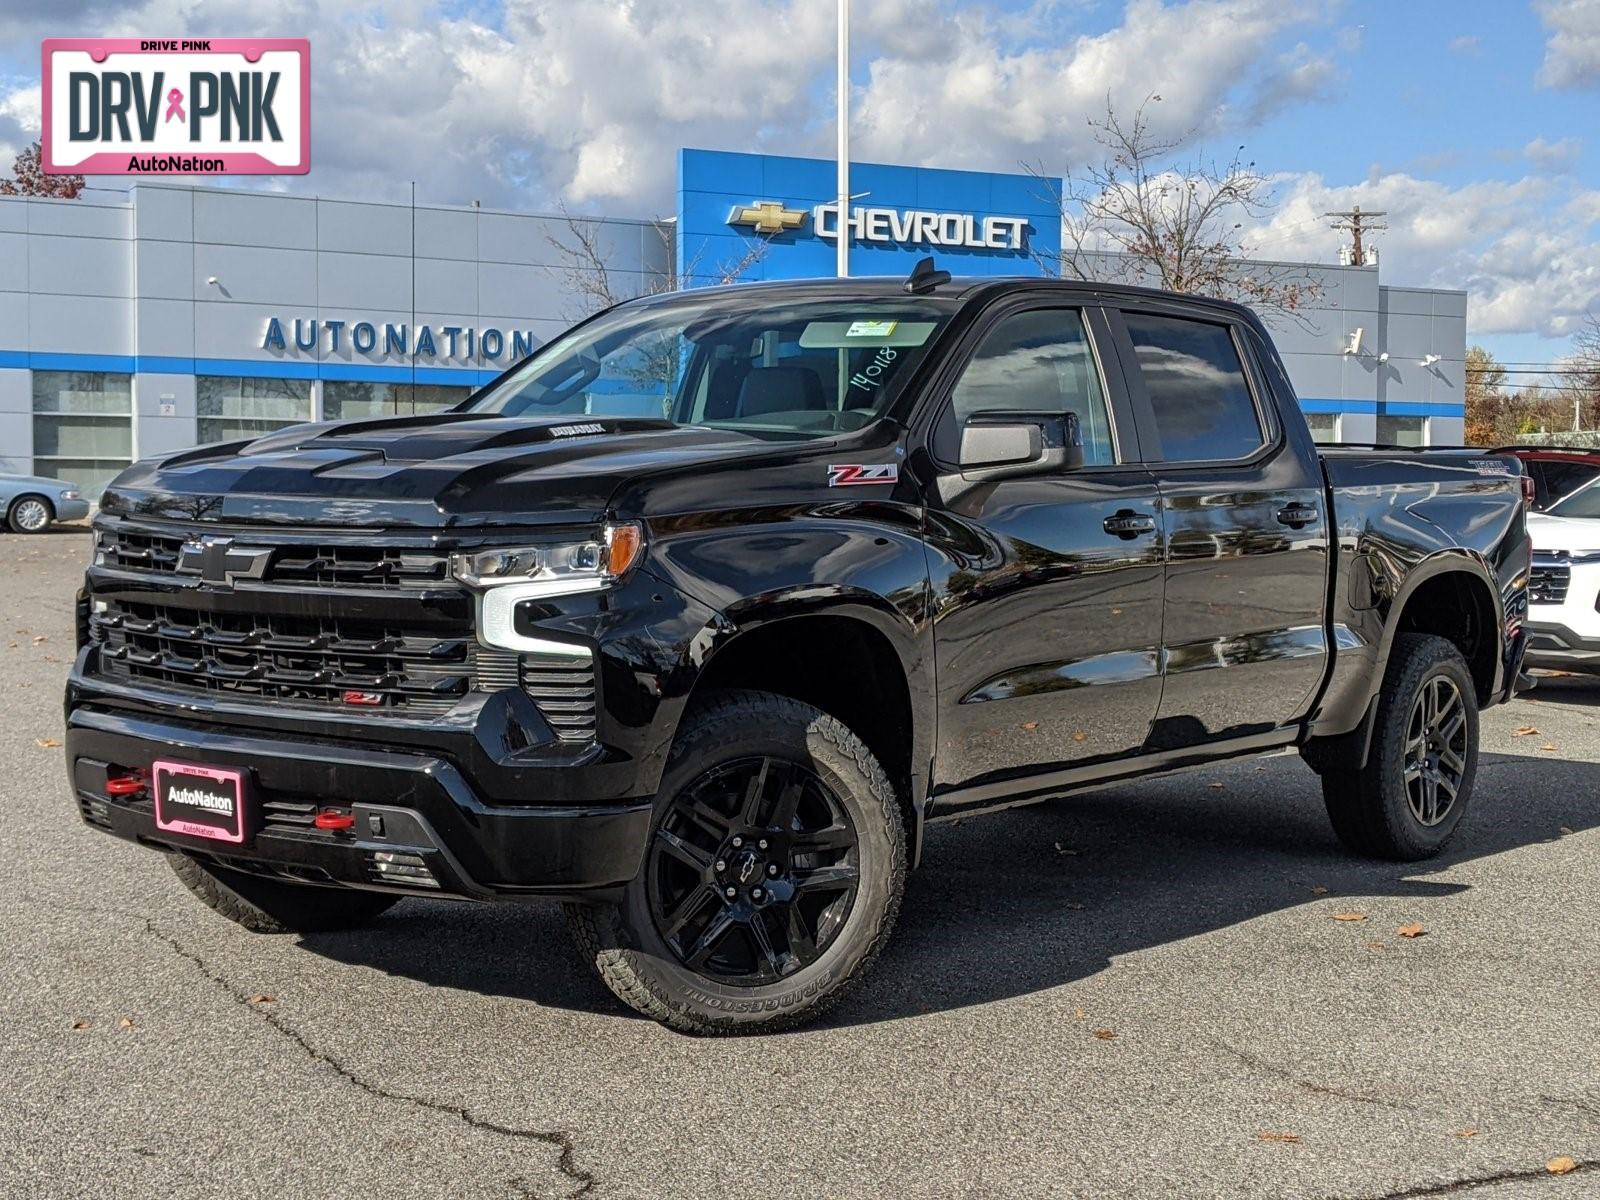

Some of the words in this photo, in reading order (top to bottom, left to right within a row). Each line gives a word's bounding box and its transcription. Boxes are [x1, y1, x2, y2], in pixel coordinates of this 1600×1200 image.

[814, 205, 1029, 249] CHEVROLET
[262, 317, 534, 361] AUTONATION
[168, 786, 233, 810] AutoNation
[182, 825, 216, 837] AutoNation
